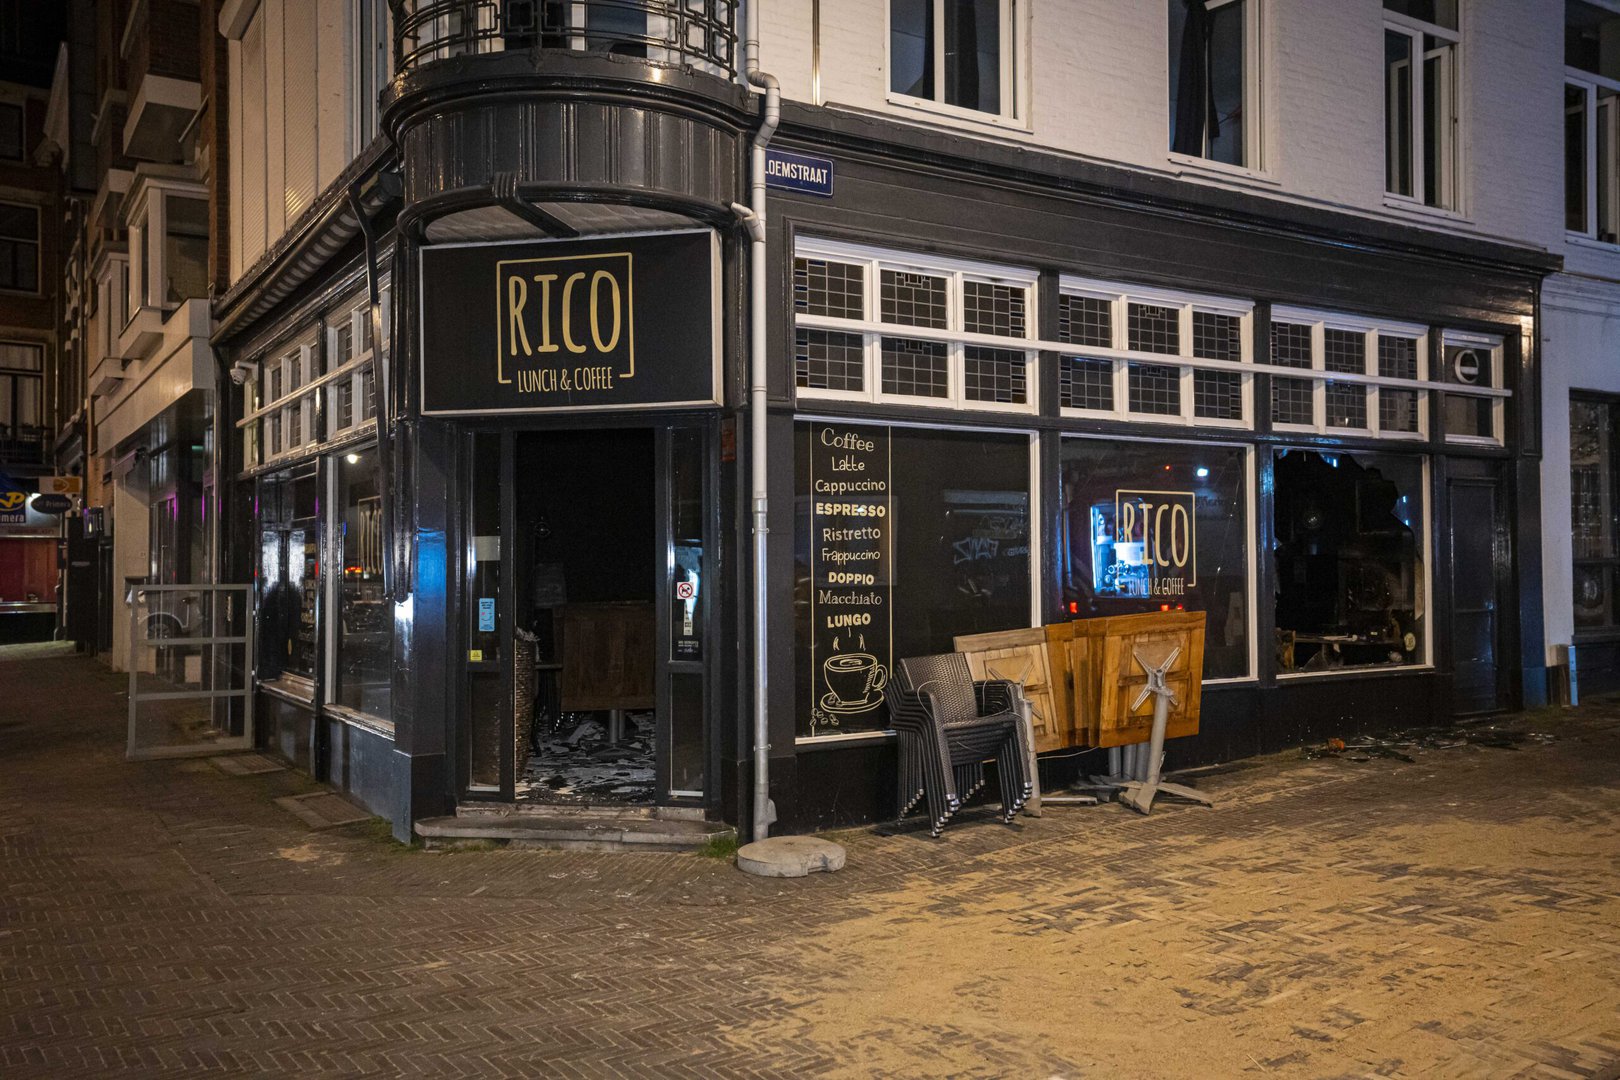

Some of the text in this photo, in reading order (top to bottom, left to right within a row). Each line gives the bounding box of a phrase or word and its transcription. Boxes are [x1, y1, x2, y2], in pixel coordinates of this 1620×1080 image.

[766, 160, 828, 185] OEMSTRAAT
[508, 270, 621, 356] RICO
[517, 366, 614, 393] LUNCH & COFFEE
[821, 427, 875, 452] Coffee
[831, 454, 866, 472] Latte
[815, 478, 887, 496] Cappuccino
[815, 502, 886, 518] ESPRESSO
[822, 526, 881, 542] Ristretto
[1123, 502, 1189, 567] RICO
[821, 547, 881, 566] Frappuccino
[828, 571, 875, 586] DOPPIO
[1128, 577, 1185, 596] LUNCH & COFFEE
[818, 589, 883, 606] Macchiato
[827, 613, 871, 629] LUNGO
